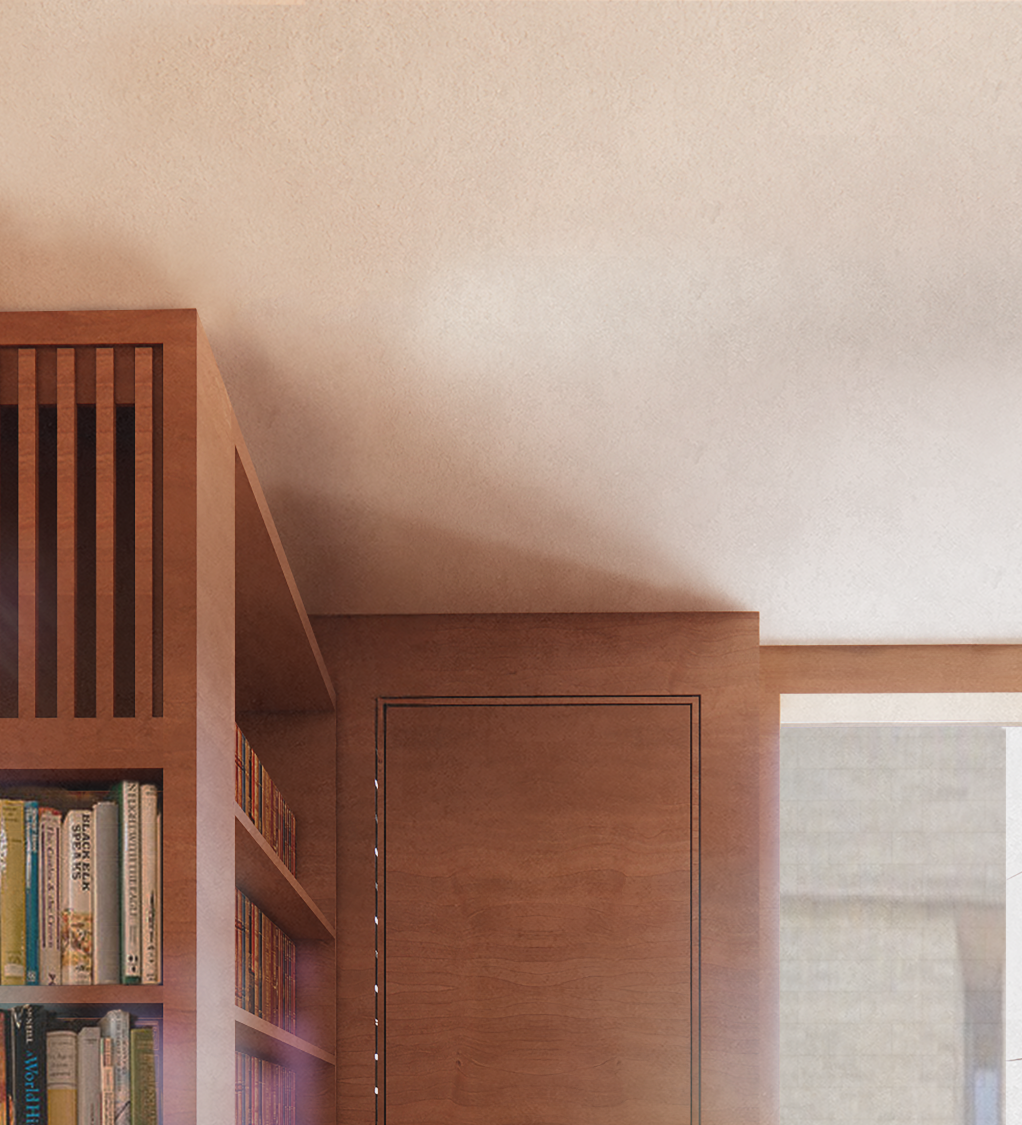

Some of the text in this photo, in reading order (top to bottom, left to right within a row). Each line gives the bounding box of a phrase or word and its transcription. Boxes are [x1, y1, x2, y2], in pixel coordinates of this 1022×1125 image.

[72, 825, 82, 881] SPEAKS
[82, 814, 91, 891] BLACK ELK
[24, 1056, 40, 1101] World
